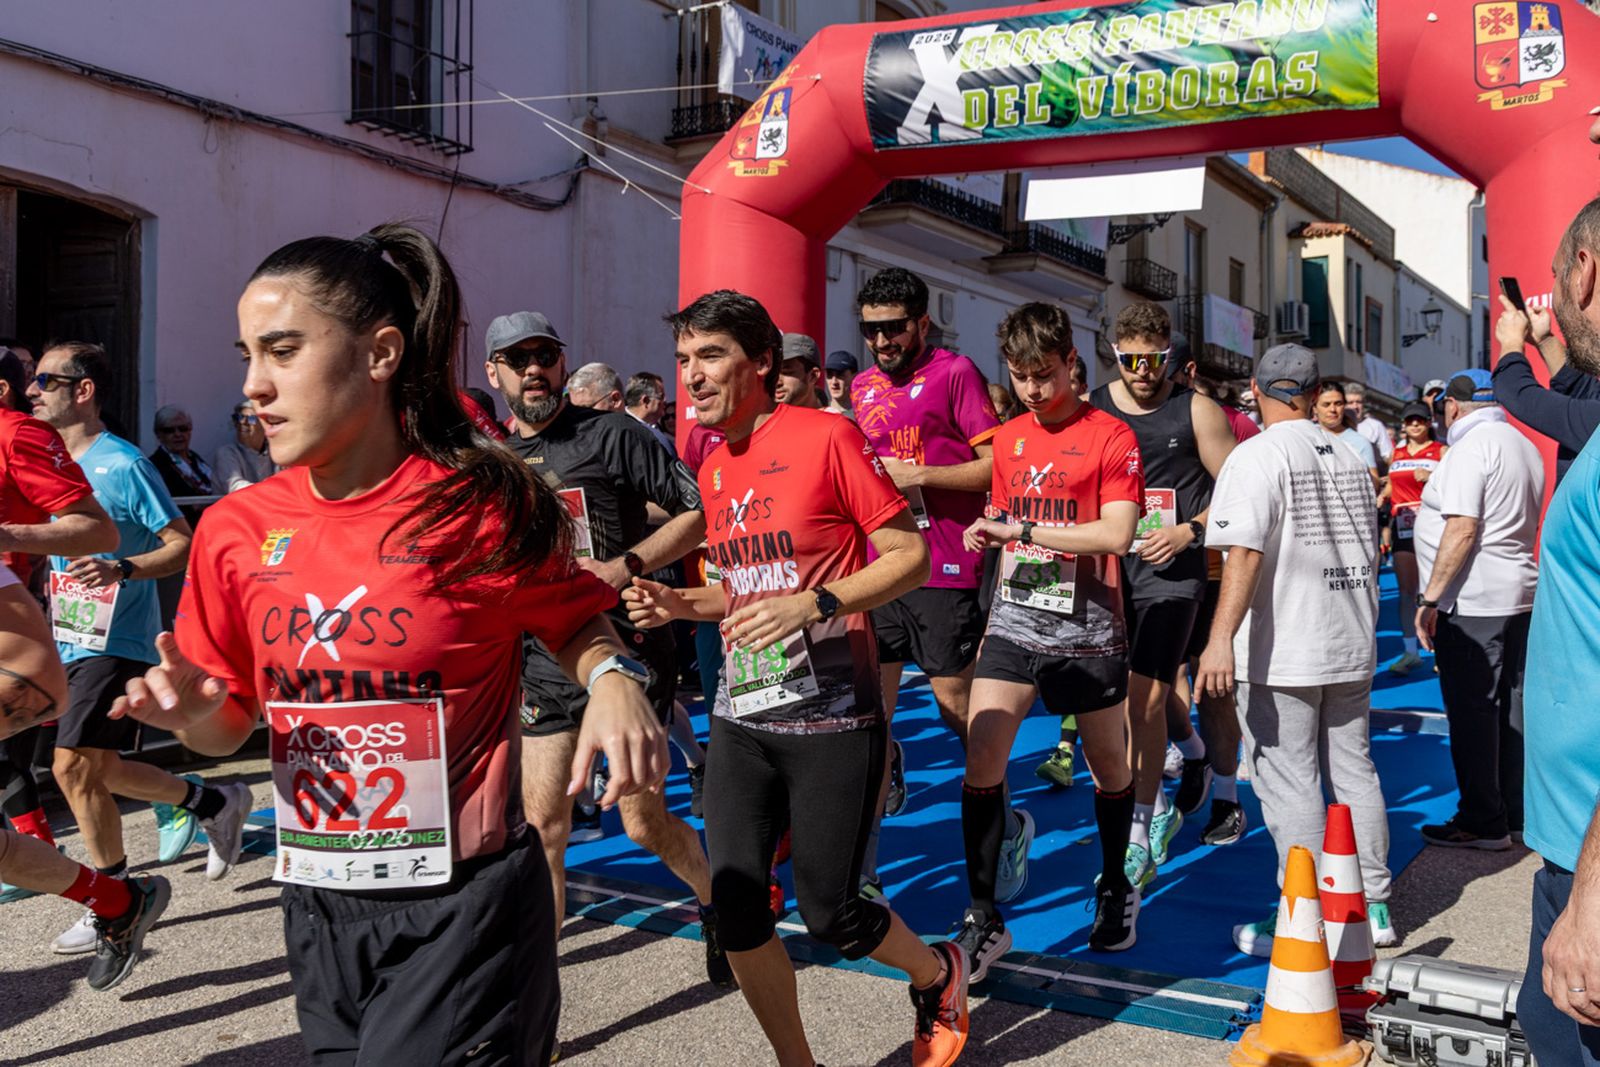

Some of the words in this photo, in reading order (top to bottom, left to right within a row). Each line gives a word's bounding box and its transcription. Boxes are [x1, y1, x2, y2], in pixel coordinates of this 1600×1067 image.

[745, 21, 774, 47] CROSS
[914, 32, 951, 45] 2026
[959, 20, 1097, 72] CROSS
[1102, 0, 1328, 57] PANTANO
[897, 24, 999, 145] X
[962, 81, 1051, 131] DEL
[1075, 51, 1319, 120] VÍBORAS
[1502, 93, 1541, 107] MARTOS
[1011, 470, 1068, 489] CROSS
[714, 497, 774, 531] CROSS
[705, 530, 795, 568] PANTANO
[262, 605, 414, 647] CROSS
[285, 714, 304, 747] X
[307, 722, 407, 751] CROSS
[286, 749, 383, 773] PANTANO
[385, 752, 408, 764] DEL
